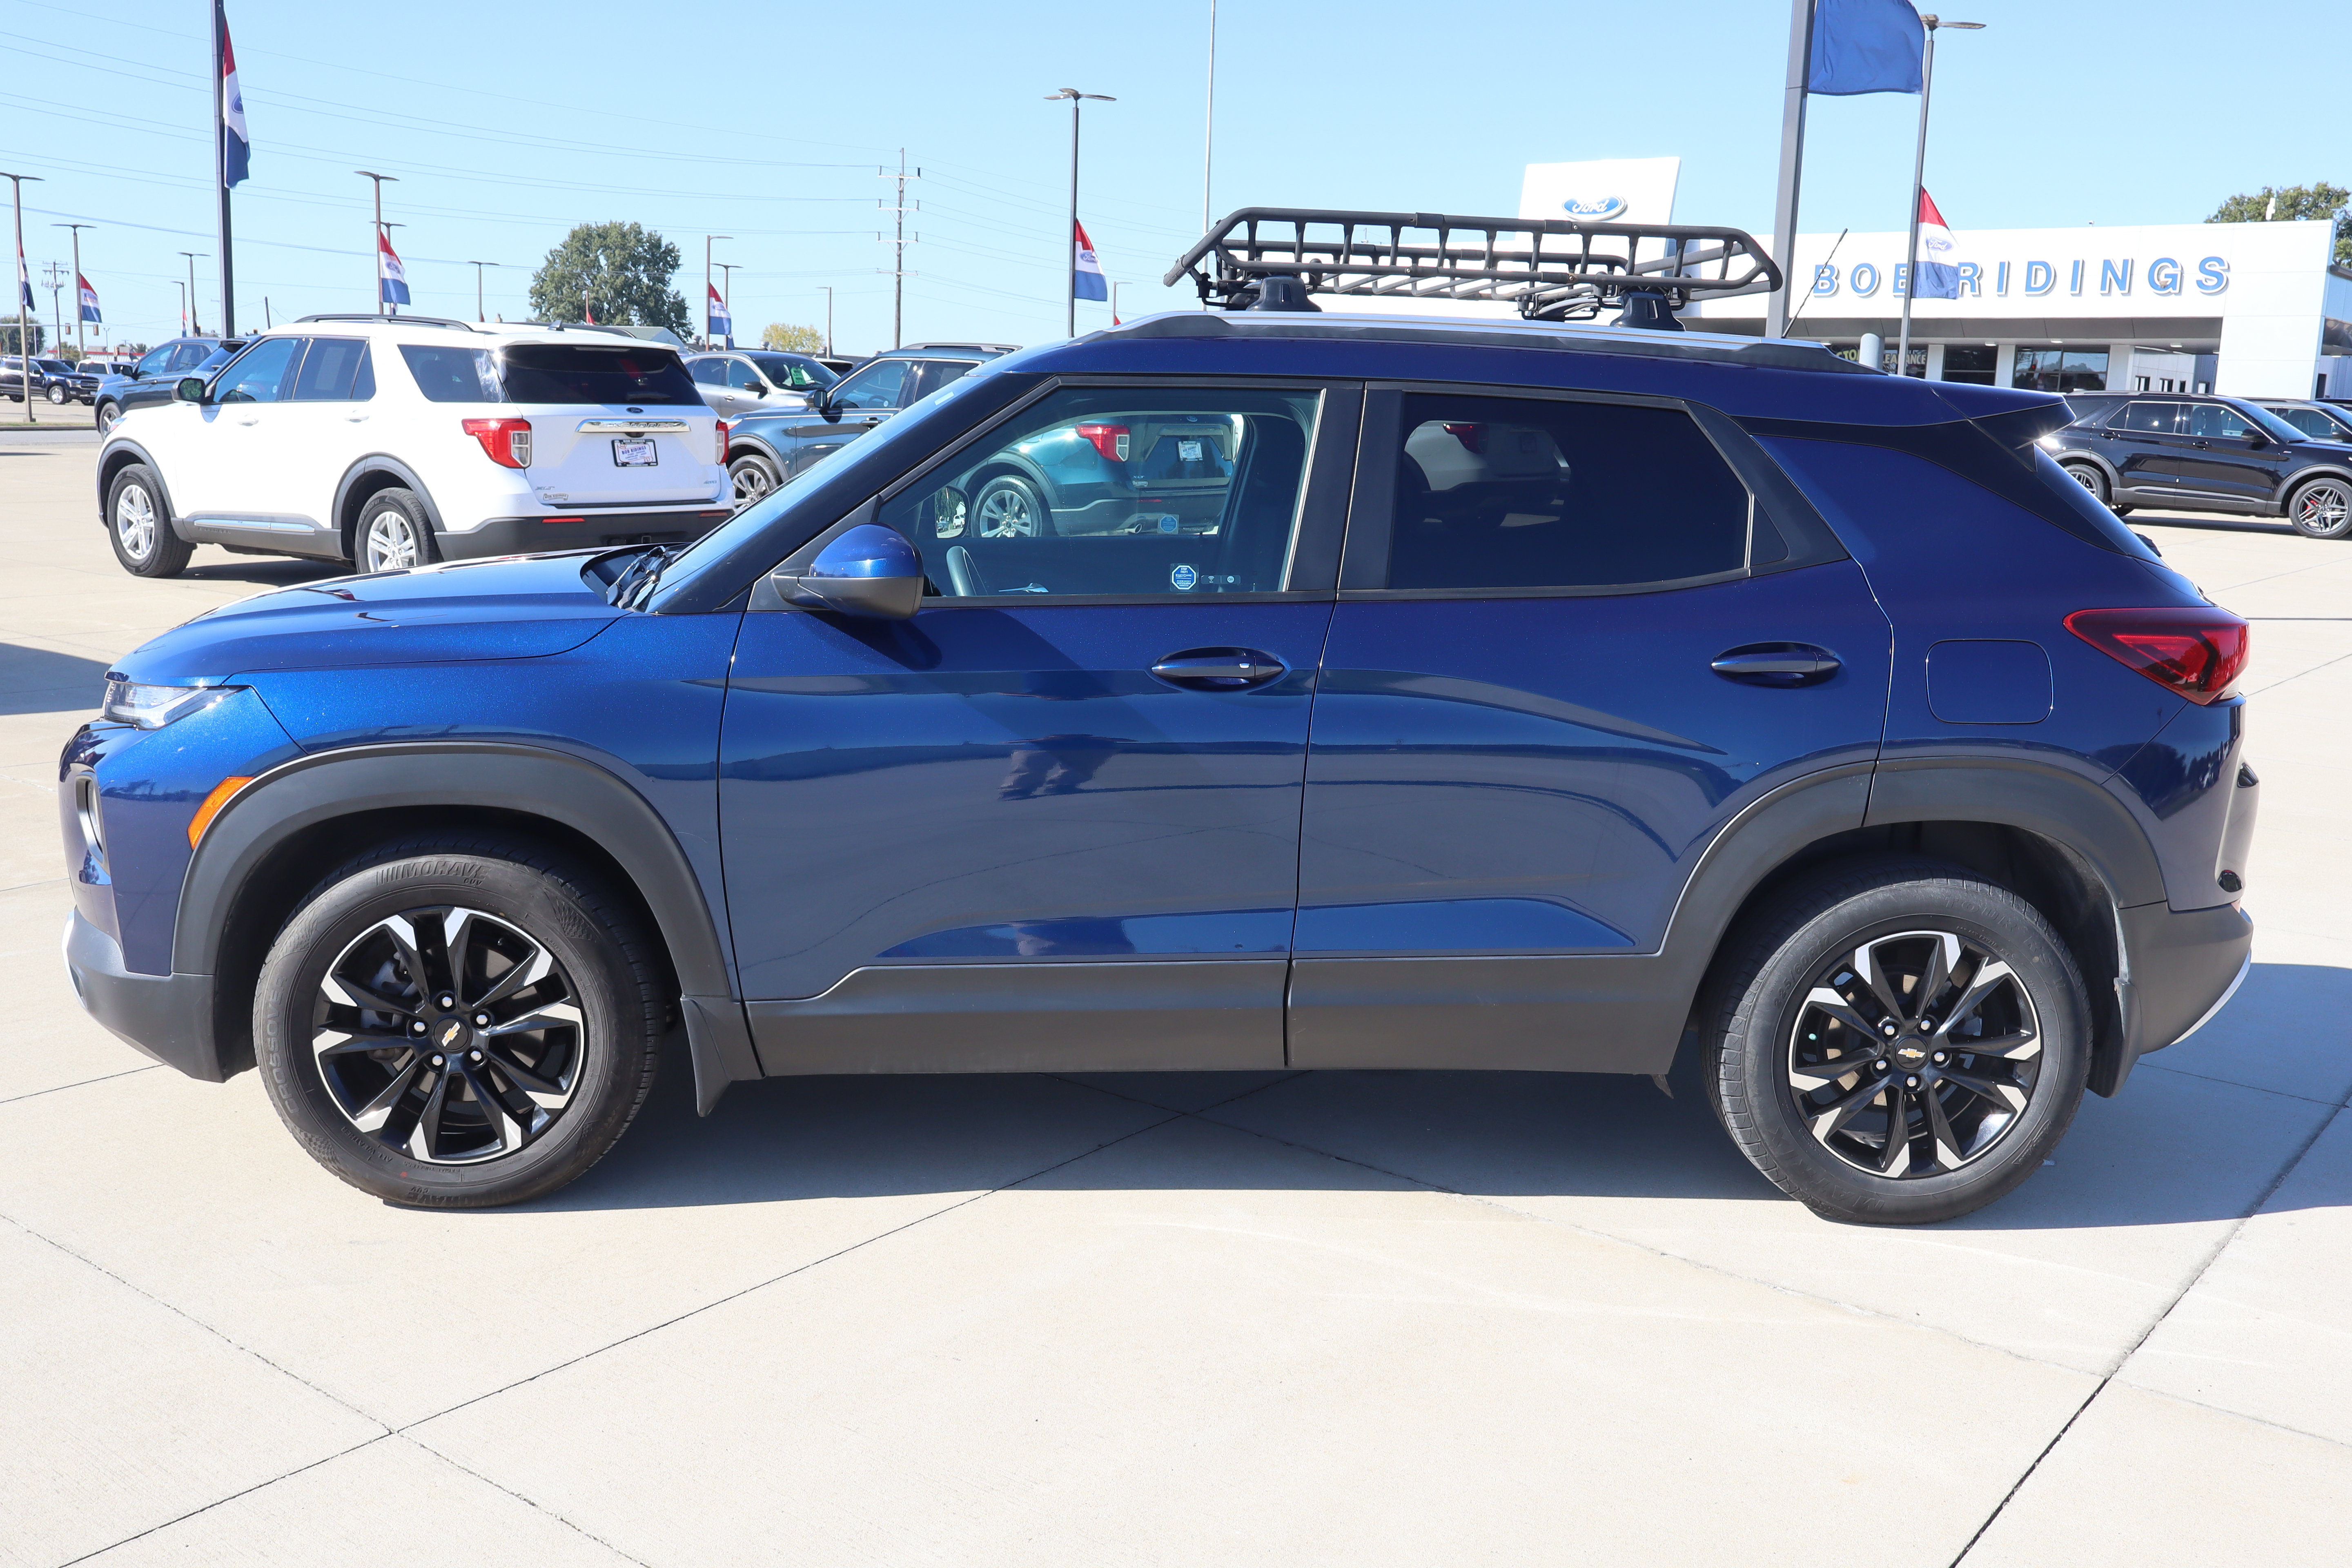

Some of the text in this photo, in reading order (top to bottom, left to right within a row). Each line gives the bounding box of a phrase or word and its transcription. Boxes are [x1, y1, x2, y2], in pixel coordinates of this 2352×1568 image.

[1572, 198, 1609, 213] Ford
[1928, 239, 1947, 250] Ford
[1958, 256, 2230, 299] RIDINGS
[402, 860, 492, 881] MOHAVE
[463, 878, 484, 886] CUV
[1773, 932, 1830, 1009] 225/60R17
[2026, 977, 2043, 1004] 225/60R17
[267, 976, 300, 1114] CROSSOVER
[341, 1126, 393, 1163] ALL WEATHER
[403, 1161, 435, 1172] TUBELESS
[410, 1186, 429, 1194] CUV
